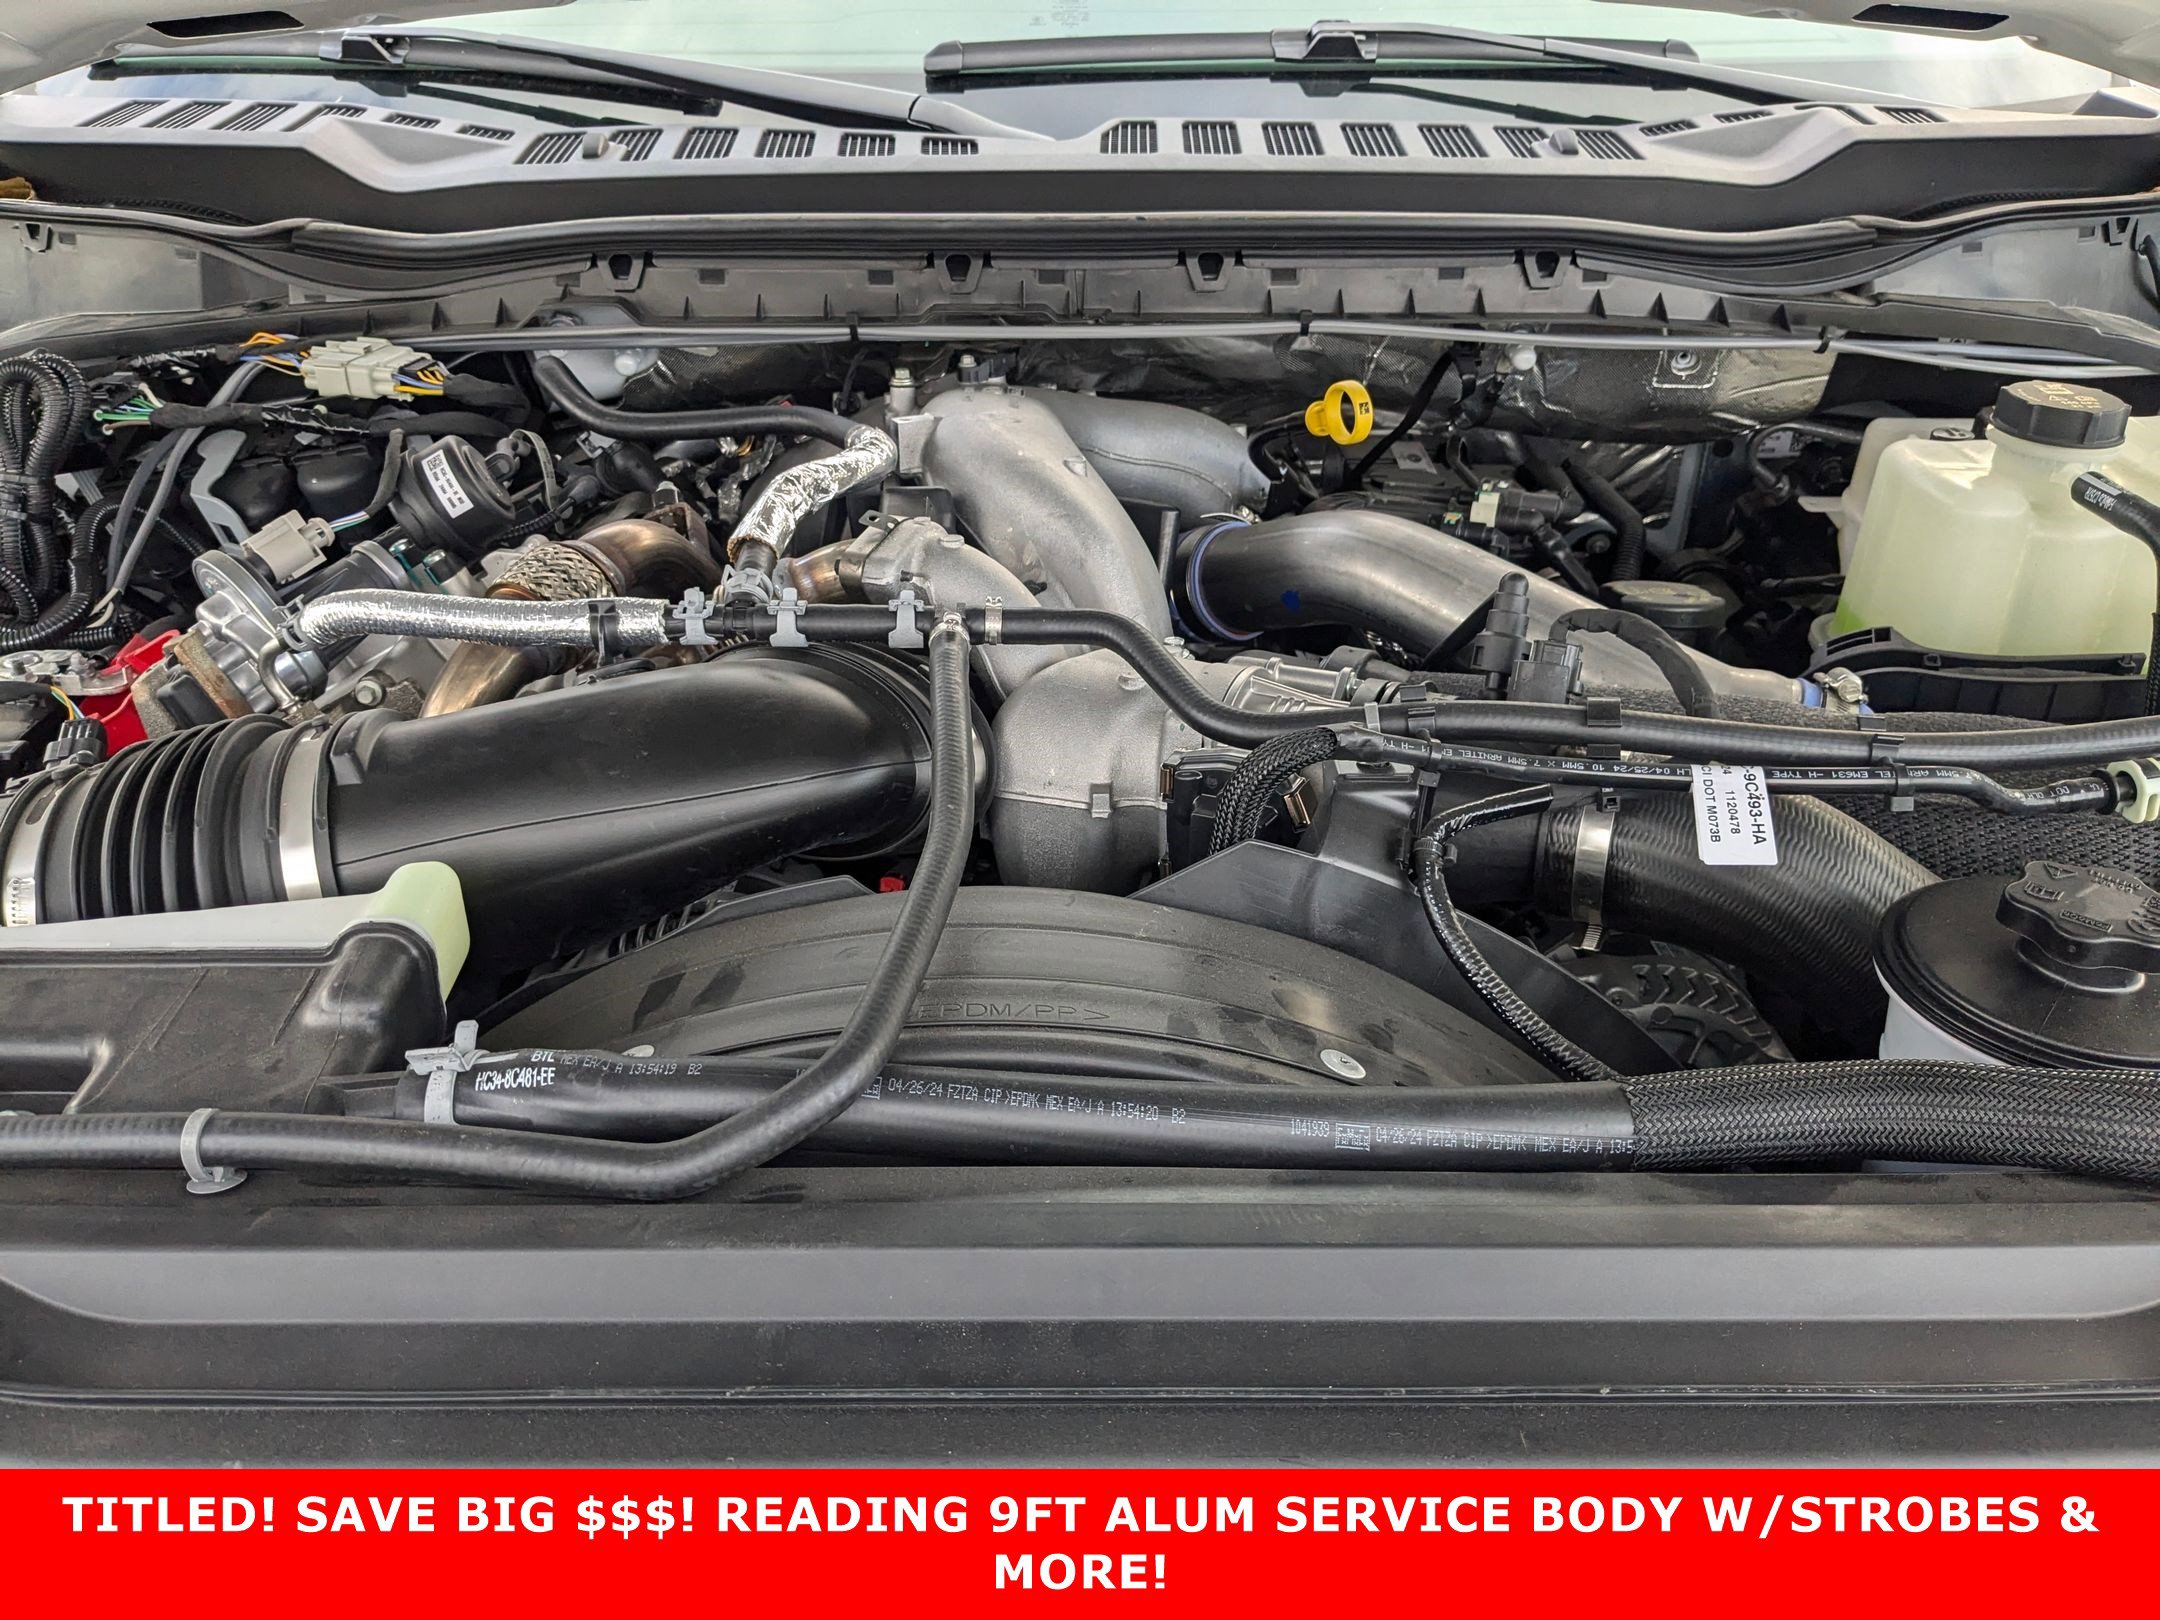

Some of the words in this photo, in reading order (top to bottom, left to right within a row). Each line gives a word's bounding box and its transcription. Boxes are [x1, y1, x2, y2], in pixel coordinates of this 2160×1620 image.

[1460, 749, 1503, 762] ARNITEL
[1613, 764, 1671, 775] 04/25/24
[1771, 770, 1801, 779] TYPE
[1831, 770, 1869, 779] EM631
[1702, 779, 1717, 803] DOT
[1724, 790, 1741, 835] 1120478
[1705, 805, 1722, 843] M073B
[629, 1063, 677, 1075] 13:54:19
[687, 1064, 702, 1075] B2
[1111, 1101, 1159, 1121] 13:54:20
[1171, 1108, 1186, 1124] B2
